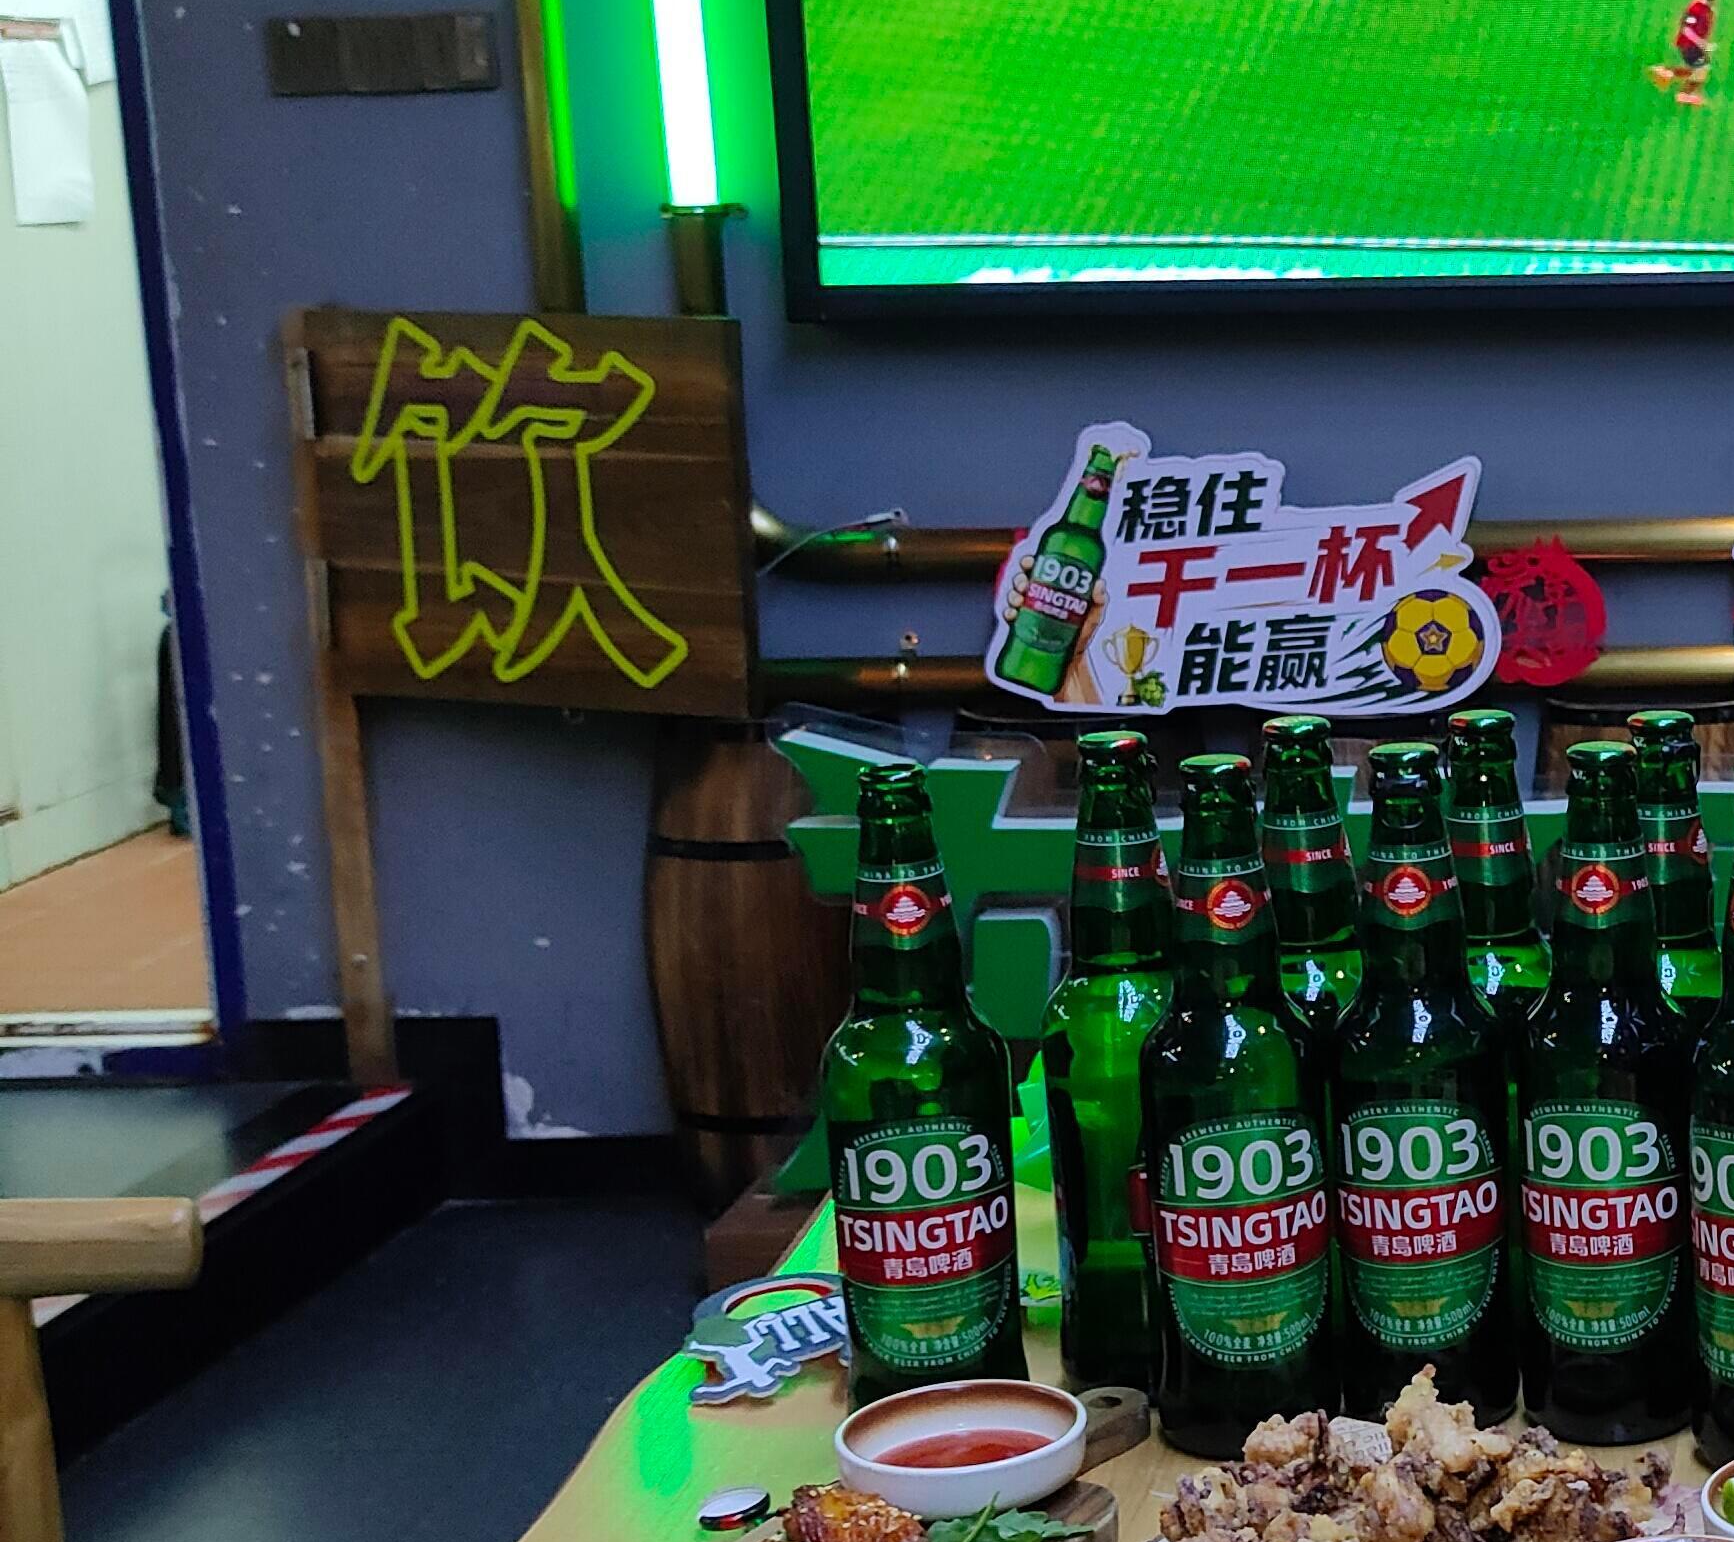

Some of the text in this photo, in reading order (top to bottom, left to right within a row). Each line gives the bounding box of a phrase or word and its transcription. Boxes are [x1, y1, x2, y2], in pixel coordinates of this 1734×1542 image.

[1116, 470, 1269, 543] 稳住
[1033, 554, 1093, 594] 1903
[1126, 523, 1402, 630] 干一杯
[1176, 613, 1338, 696] 能赢
[1110, 866, 1141, 879] SINCE
[1304, 848, 1333, 862] SINCE
[1488, 841, 1516, 855] SINCE
[1647, 841, 1676, 854] SINCE
[843, 1134, 992, 1204] 1903
[1168, 1128, 1314, 1200] 1903
[1340, 1118, 1480, 1182] 1903
[1523, 1118, 1661, 1182] 1903
[839, 1195, 1009, 1254] TSINGTAO
[1159, 1190, 1327, 1249] TSINGTAO
[1337, 1180, 1498, 1231] TSINGTAO
[1520, 1183, 1679, 1231] TSINGTAO
[756, 1295, 850, 1352] ALL
